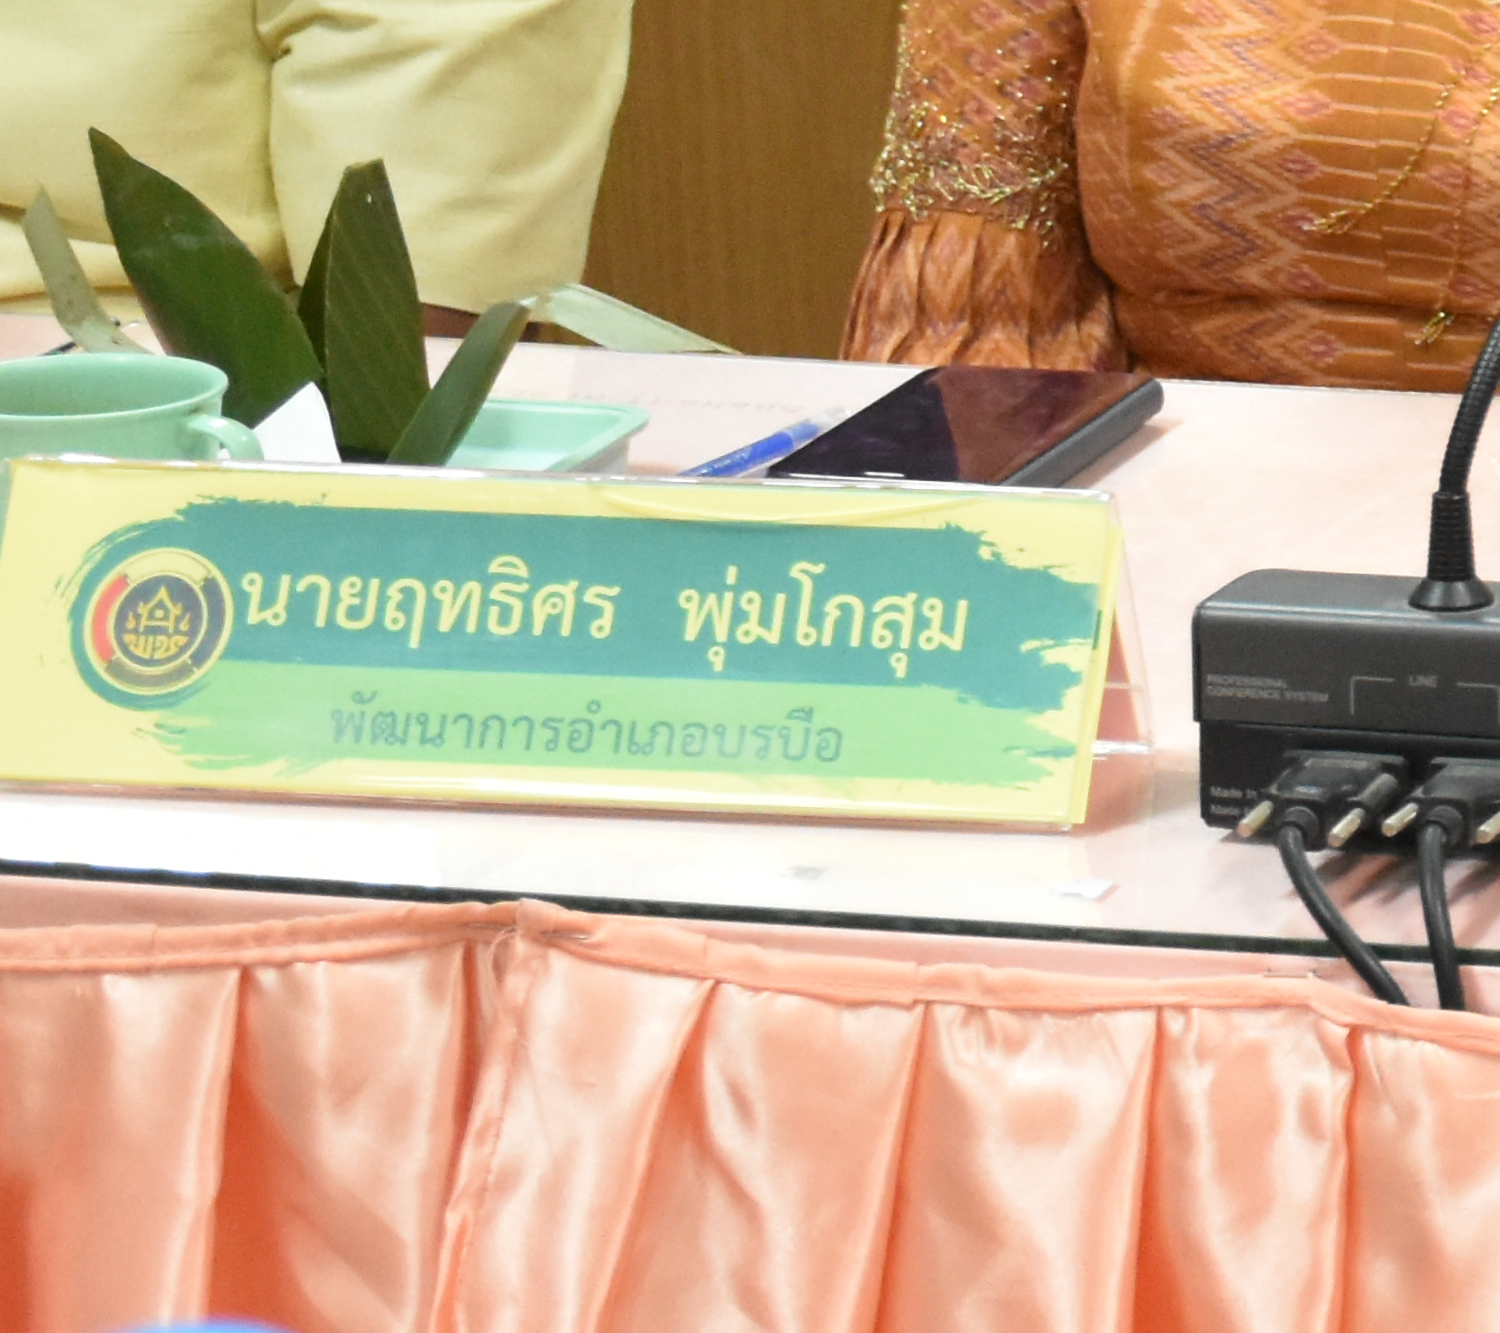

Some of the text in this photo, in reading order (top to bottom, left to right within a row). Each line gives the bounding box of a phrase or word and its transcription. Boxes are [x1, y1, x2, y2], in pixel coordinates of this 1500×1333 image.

[241, 554, 970, 680] นายฤทธิศร พุ่มโกสุม
[1409, 675, 1437, 688] LINE
[330, 690, 845, 763] พัฒนาการอำเภอบรบือ
